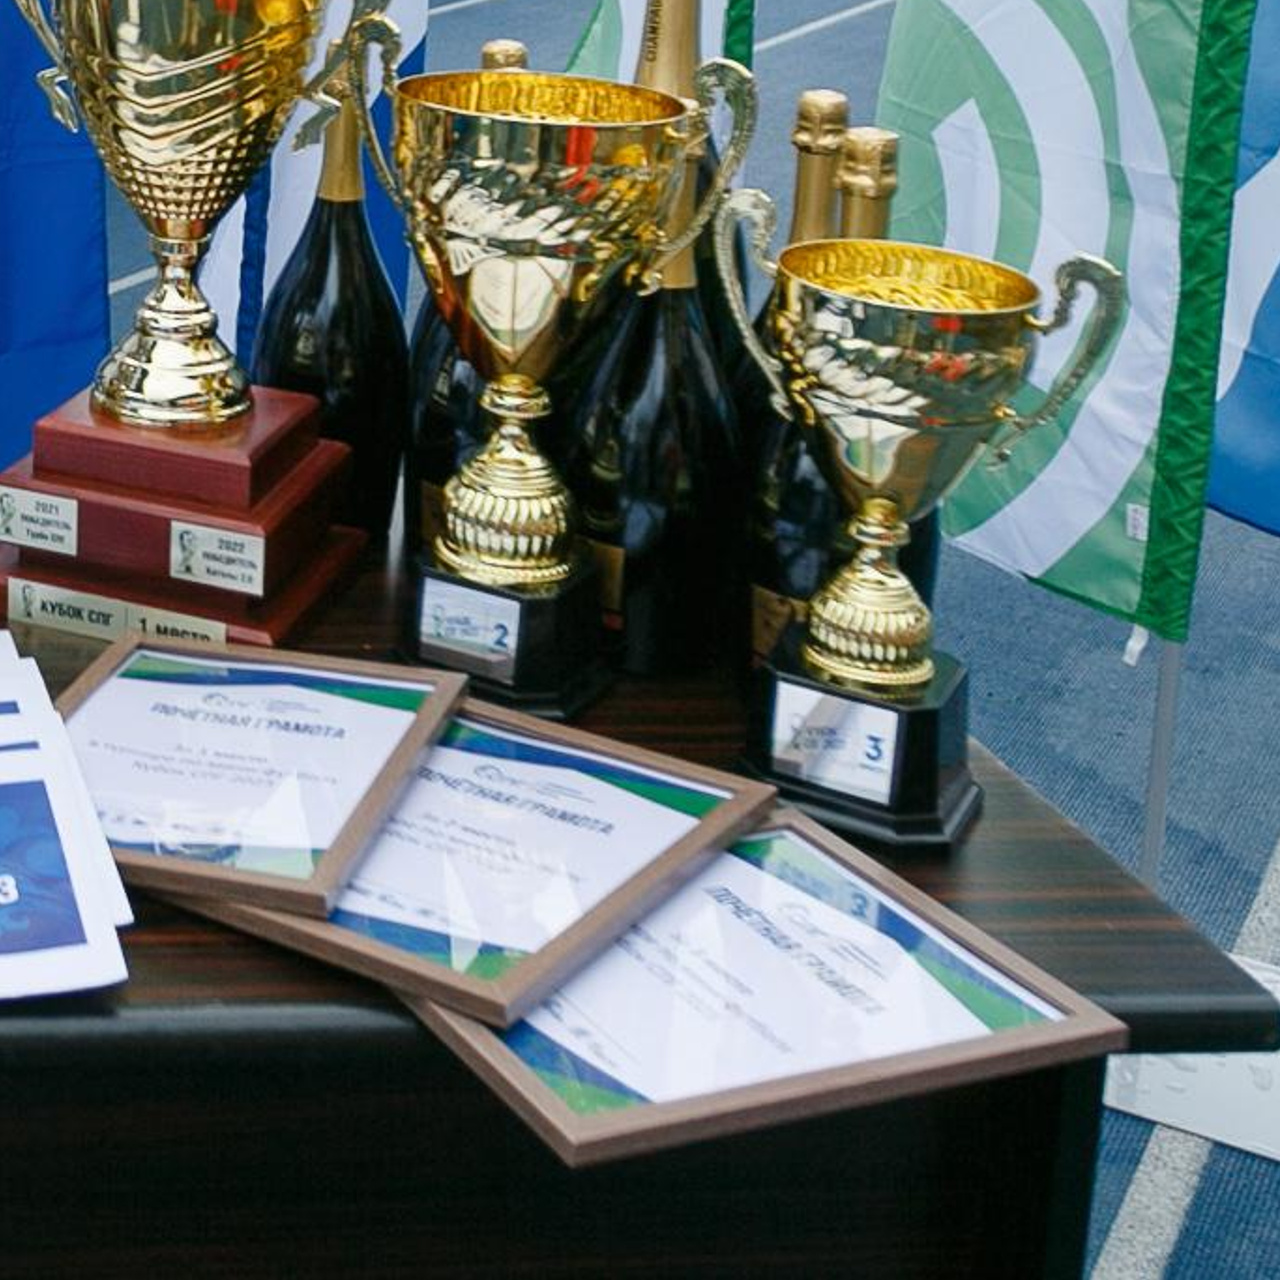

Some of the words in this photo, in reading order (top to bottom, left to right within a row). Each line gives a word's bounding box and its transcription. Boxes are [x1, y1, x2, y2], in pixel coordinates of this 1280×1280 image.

[39, 599, 84, 621] КУБОК
[87, 609, 114, 627] СПГ
[493, 622, 509, 649] 2
[865, 733, 883, 761] 3
